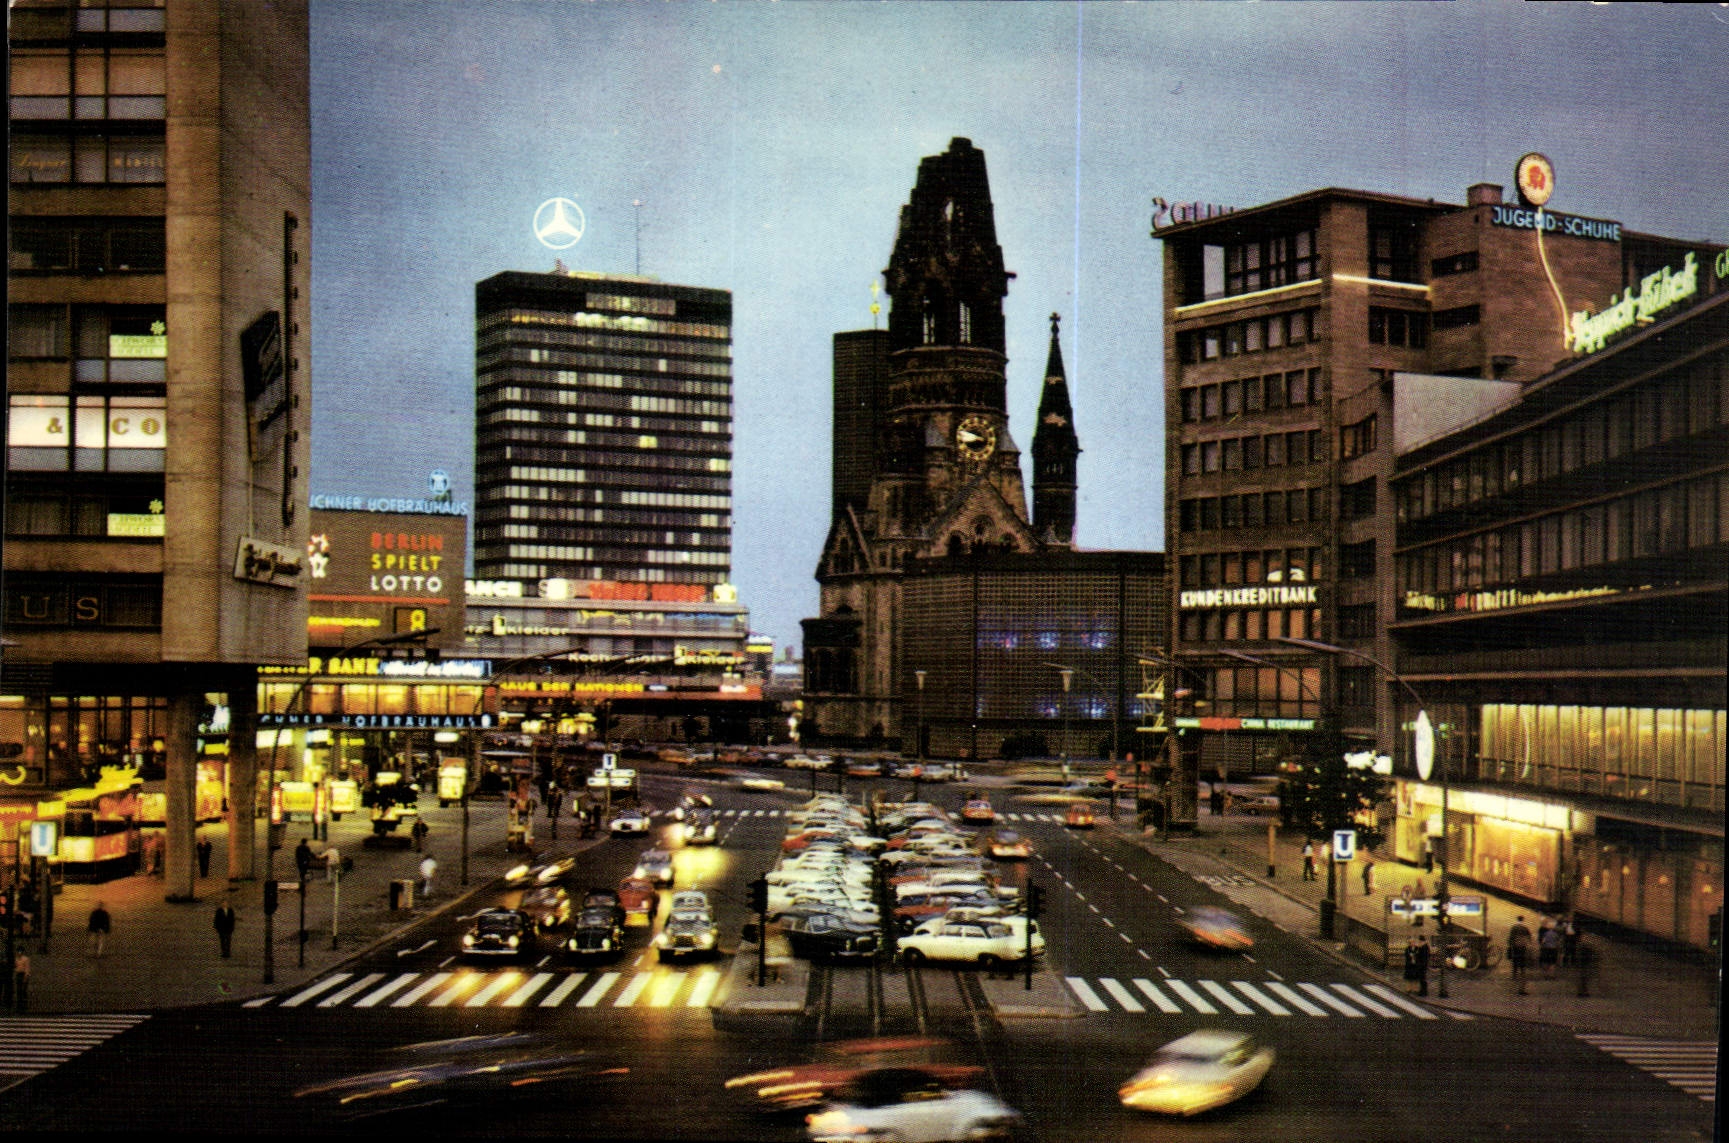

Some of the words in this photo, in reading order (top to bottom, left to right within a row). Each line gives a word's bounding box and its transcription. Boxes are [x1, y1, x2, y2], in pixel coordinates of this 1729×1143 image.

[47, 417, 63, 434] &
[111, 417, 161, 435] CO
[371, 532, 443, 550] BERLIN
[371, 553, 443, 571] SPIELT
[370, 574, 443, 593] LOTTO
[1180, 586, 1318, 607] KUNDENKREDITBANK
[328, 657, 379, 675] BANK
[1334, 834, 1353, 858] U
